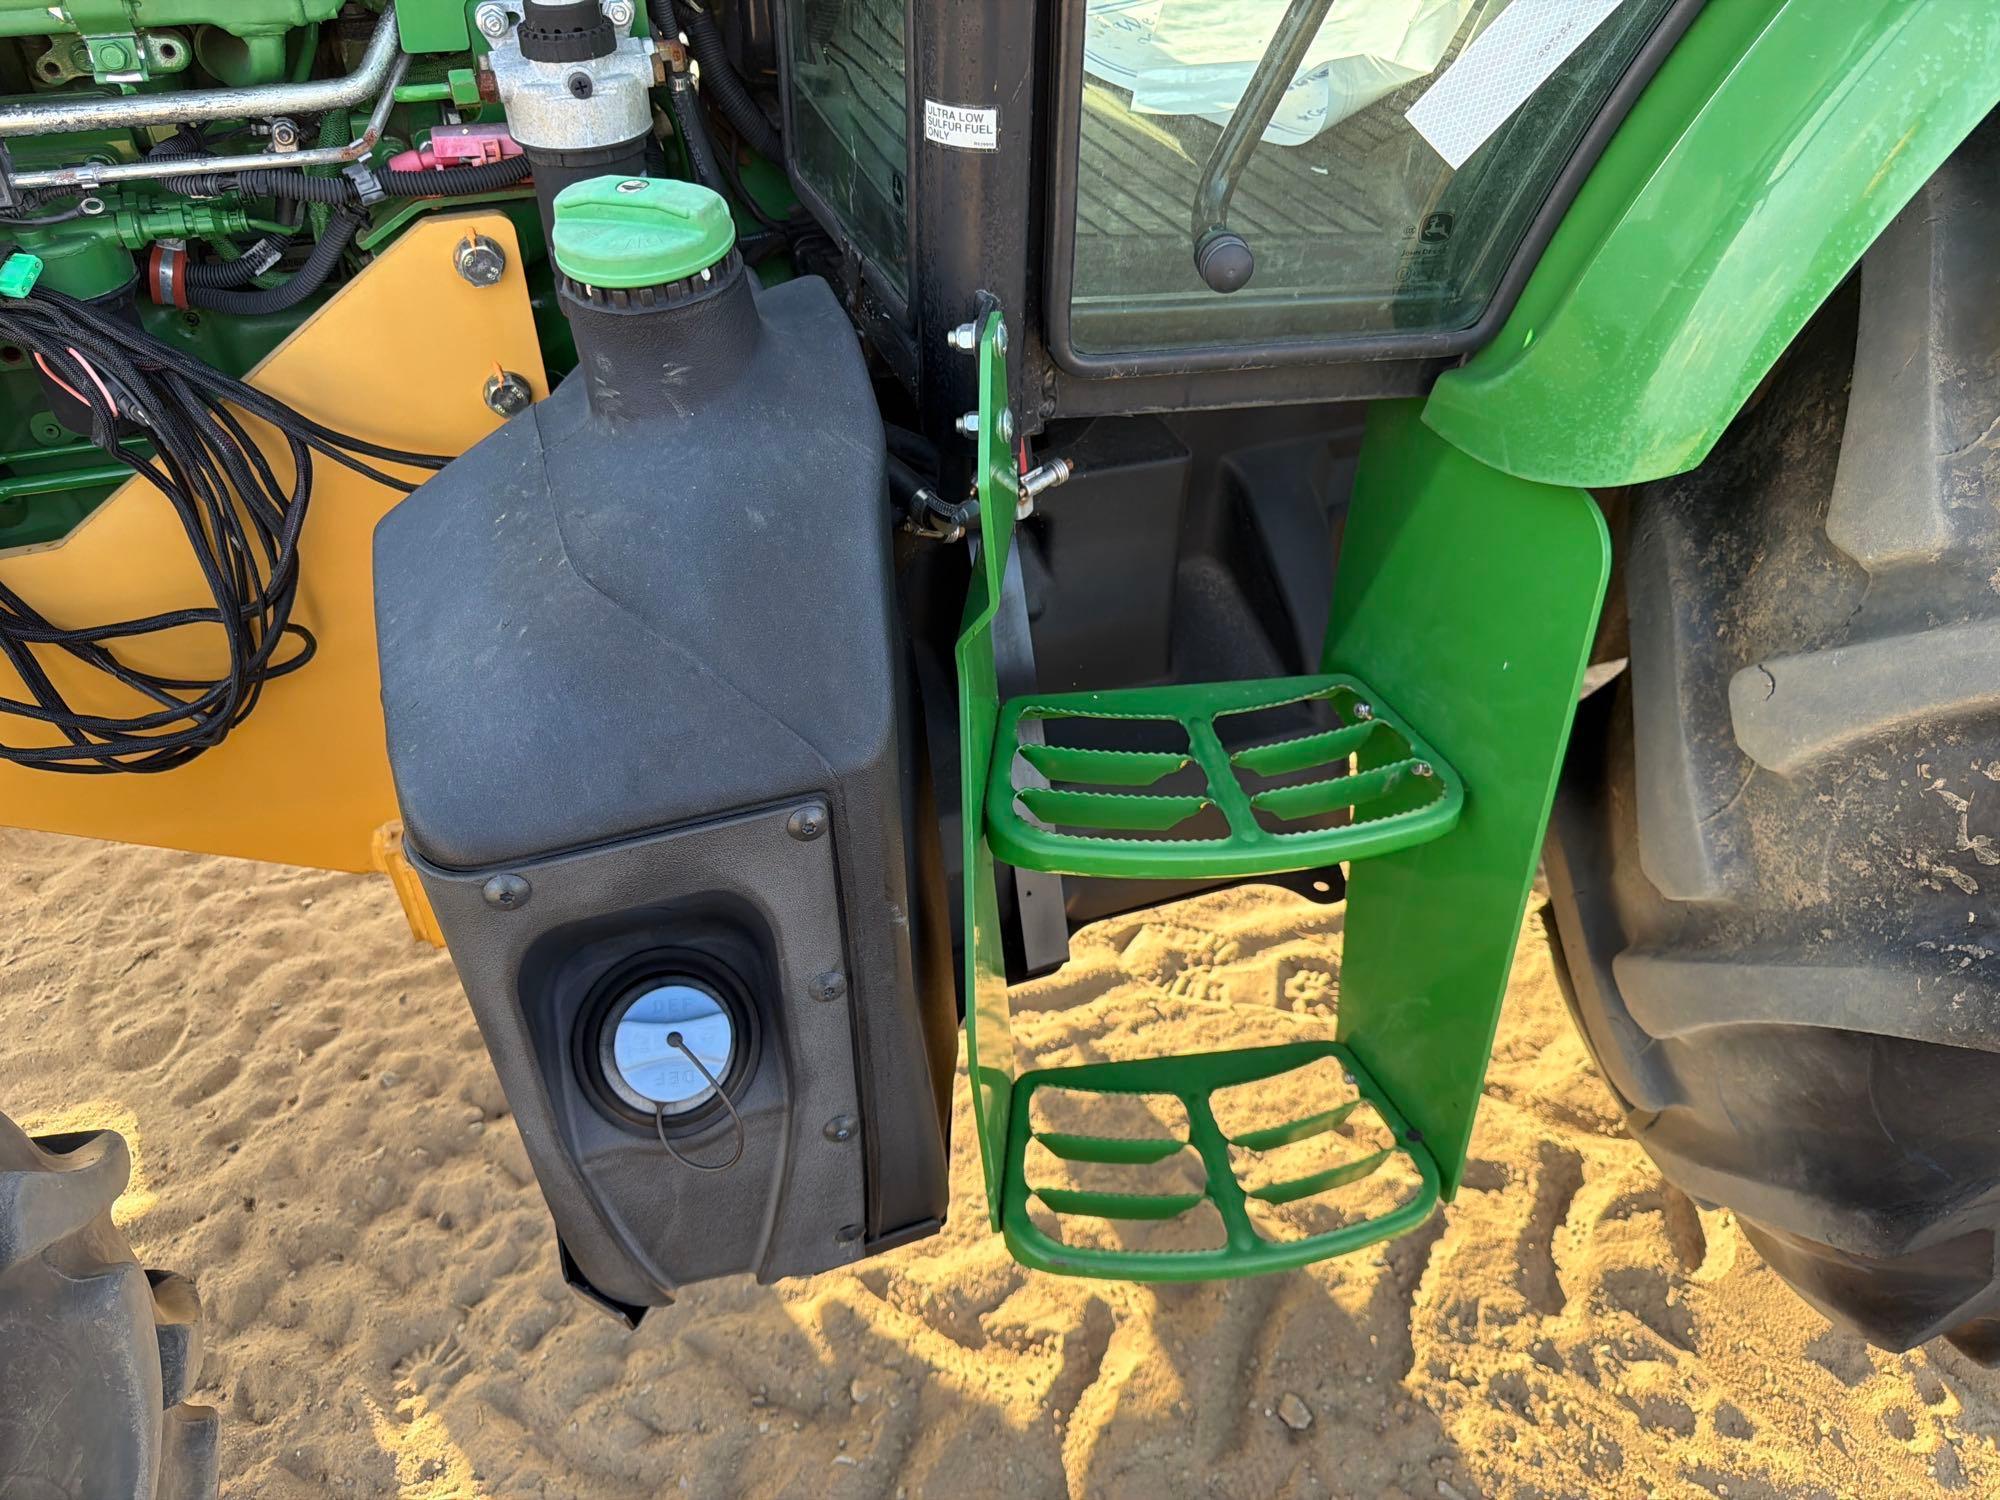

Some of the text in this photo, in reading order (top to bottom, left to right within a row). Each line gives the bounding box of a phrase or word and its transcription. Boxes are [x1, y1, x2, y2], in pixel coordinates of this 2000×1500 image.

[927, 106, 984, 123] ULTRA LOW
[927, 116, 993, 134] SULFUR FUEL
[927, 127, 950, 141] ONLY
[654, 999, 694, 1014] DEF
[654, 1070, 695, 1087] DEF
